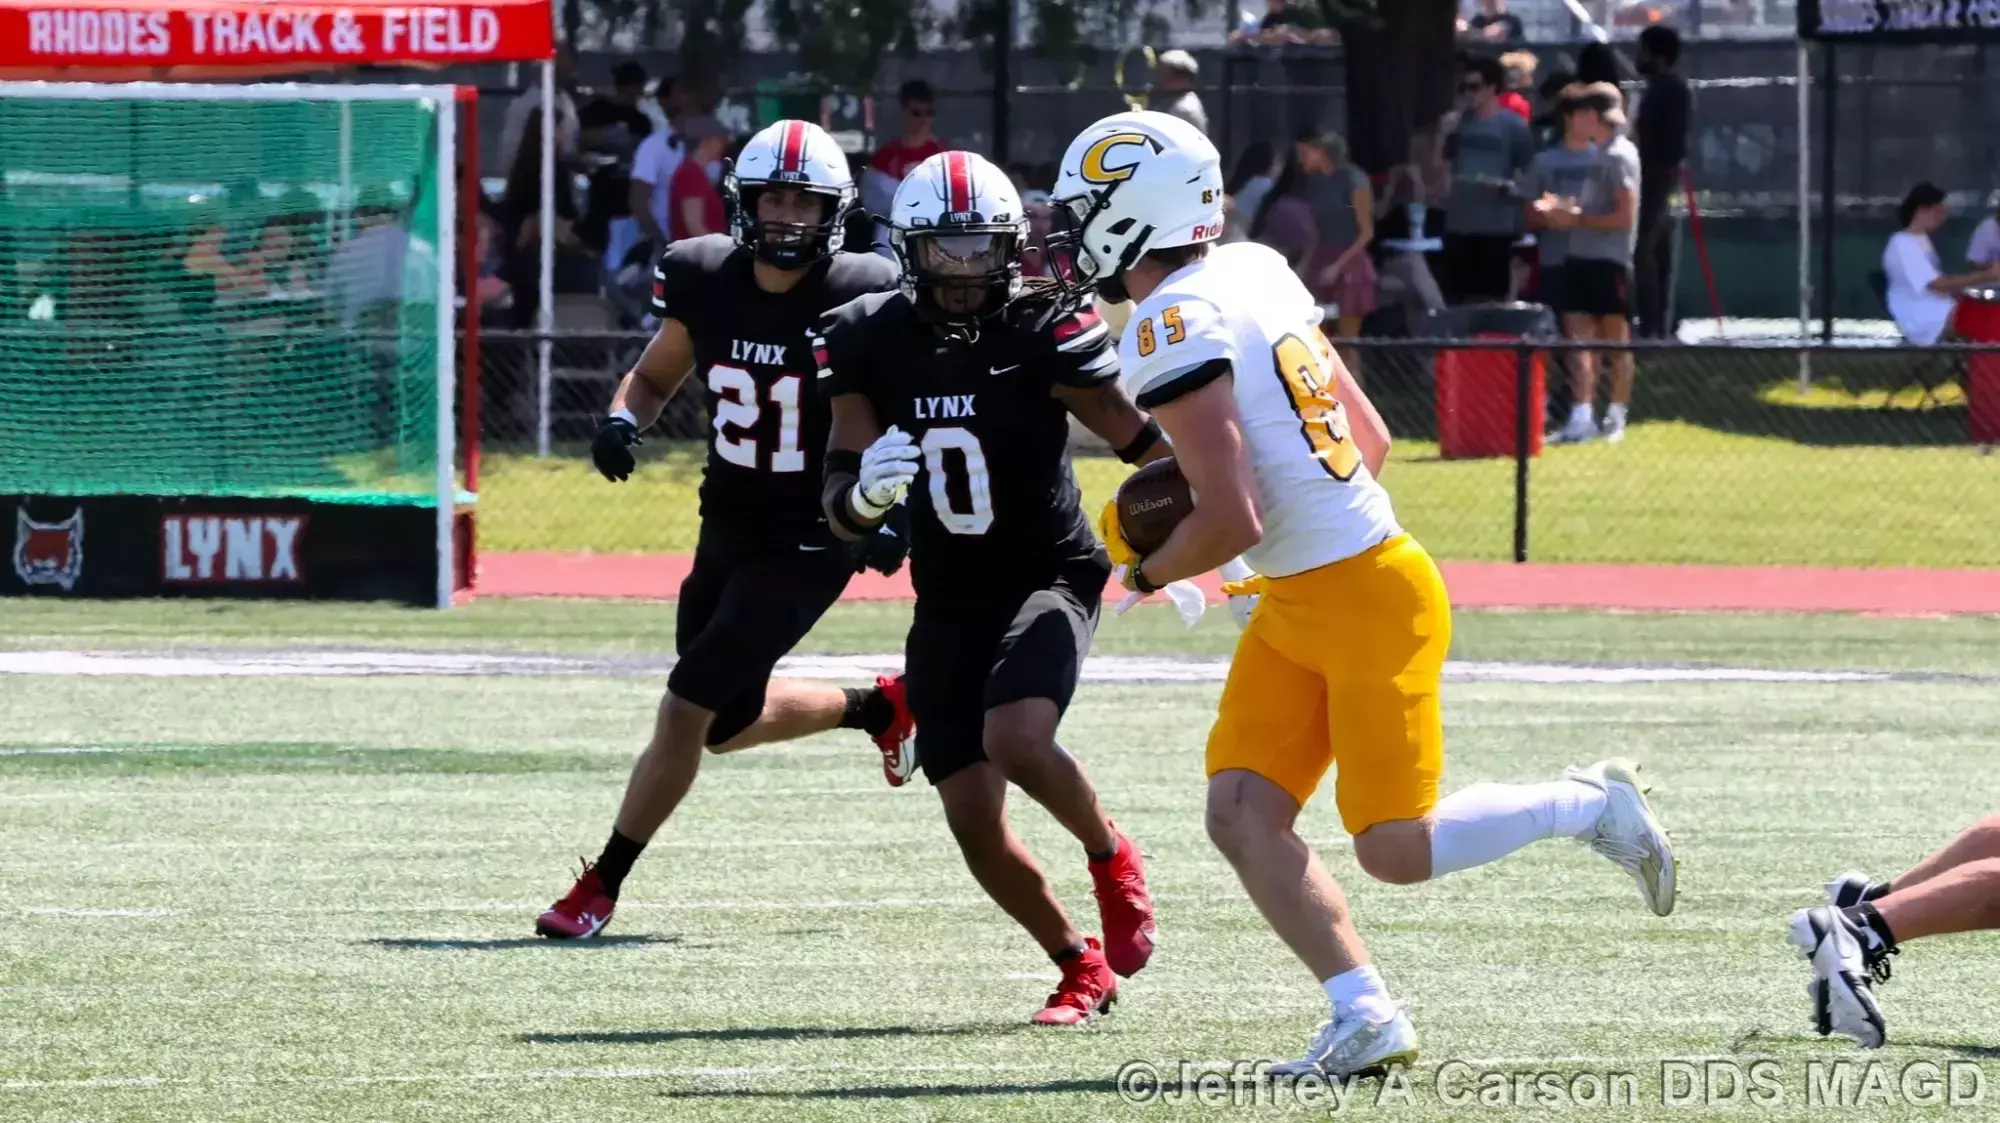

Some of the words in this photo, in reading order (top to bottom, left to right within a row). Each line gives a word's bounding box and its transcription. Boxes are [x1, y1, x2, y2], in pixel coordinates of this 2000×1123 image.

[28, 10, 170, 54] RHODES
[186, 9, 322, 55] TRACK
[330, 8, 364, 52] &
[382, 8, 500, 53] FIELD
[1081, 133, 1148, 185] C
[949, 212, 972, 222] LYNX
[1202, 189, 1213, 204] 85
[731, 339, 788, 366] LYNX
[1136, 305, 1186, 357] 85
[707, 363, 806, 474] 21
[914, 394, 977, 419] LYNX
[920, 426, 995, 535] 0
[1128, 496, 1173, 516] Wilson
[163, 518, 301, 579] LYNX
